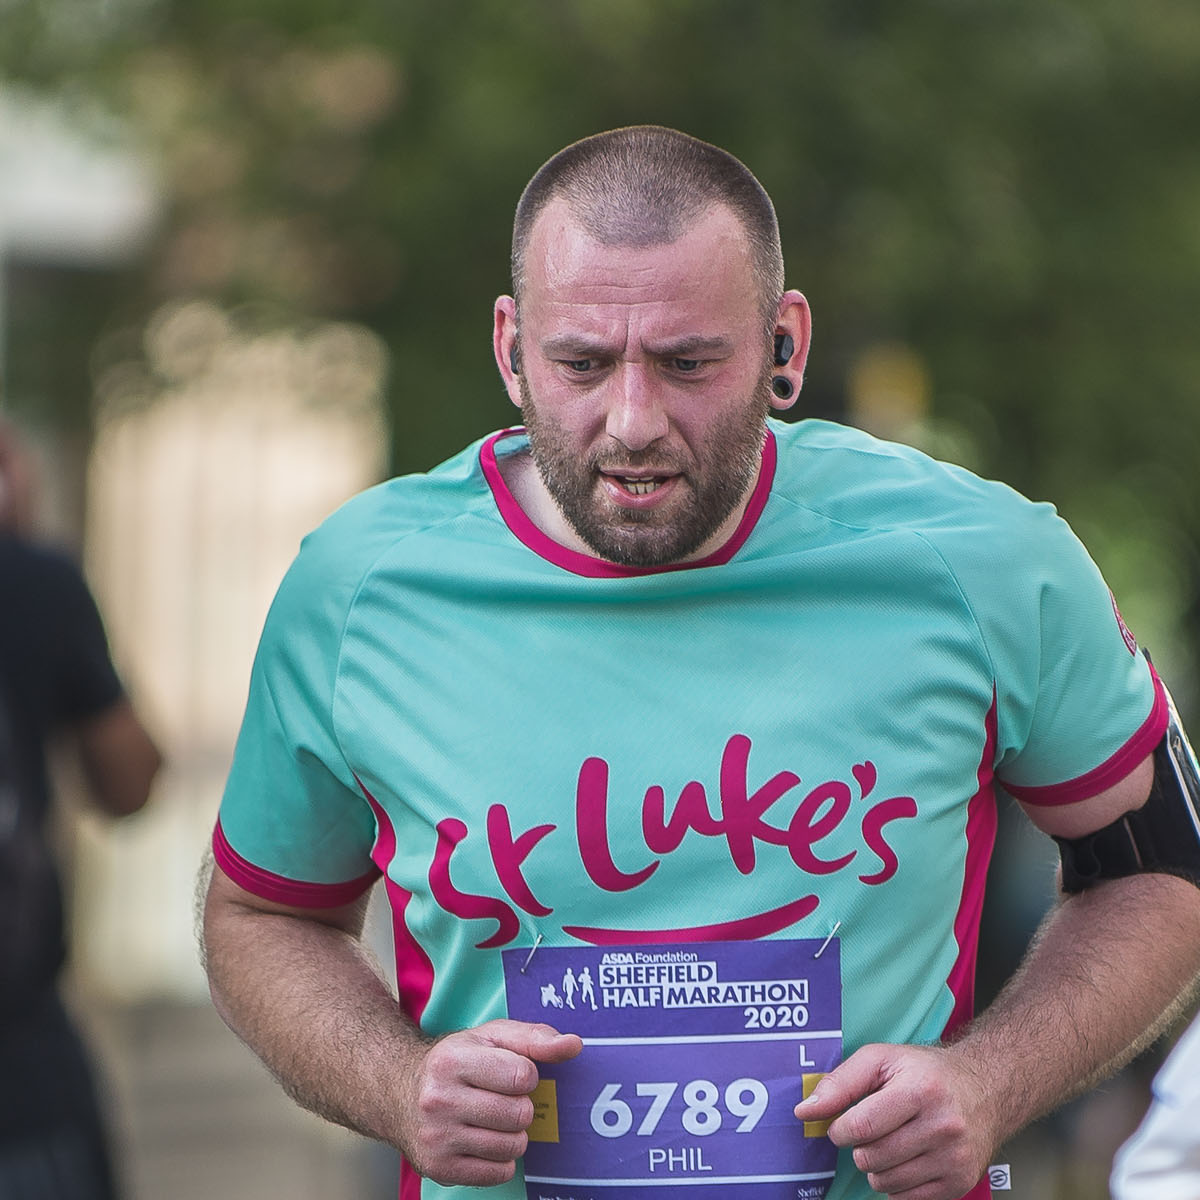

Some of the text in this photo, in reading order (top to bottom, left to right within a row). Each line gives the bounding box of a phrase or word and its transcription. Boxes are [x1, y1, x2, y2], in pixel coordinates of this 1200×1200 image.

[576, 733, 918, 892] Luke's
[602, 951, 698, 965] ASDA Foundation
[602, 964, 714, 985] SHEFFIELD
[603, 983, 806, 1008] HALF MARATHON
[744, 1005, 809, 1029] 2020
[799, 1045, 815, 1066] L
[590, 1078, 769, 1138] 6789
[649, 1148, 712, 1172] PHIL
